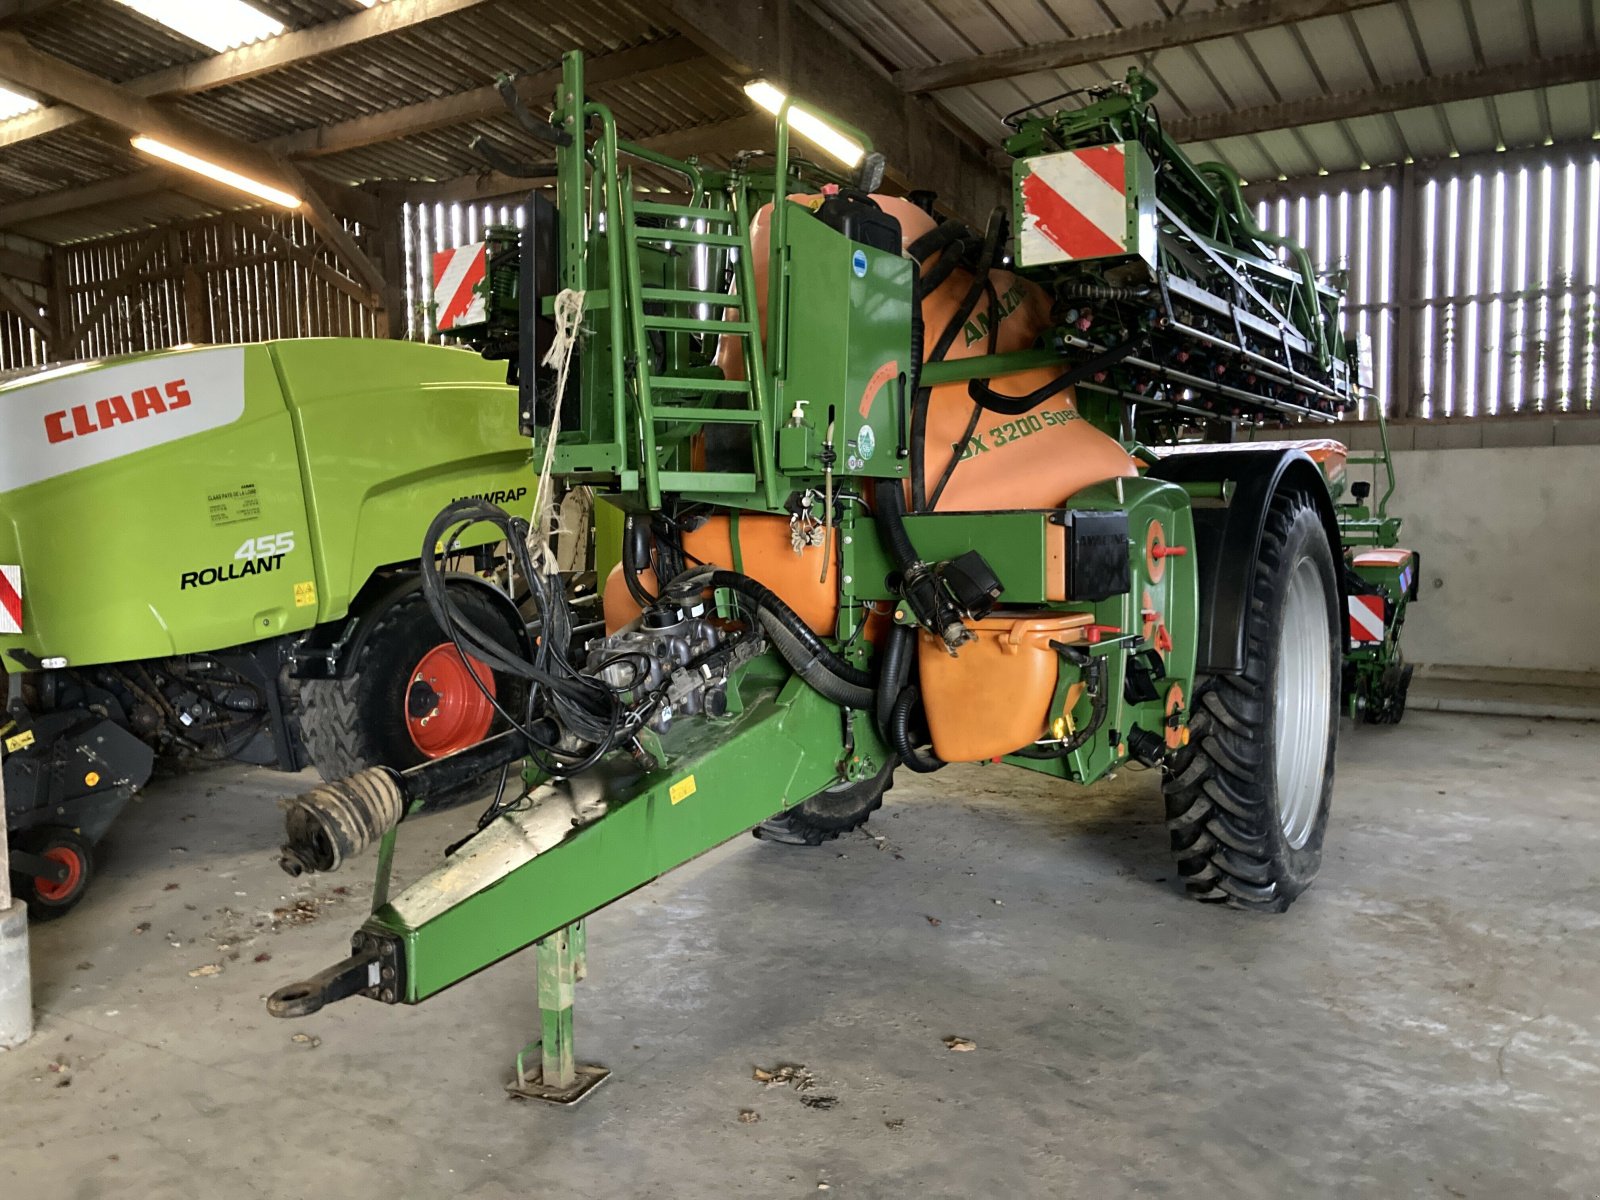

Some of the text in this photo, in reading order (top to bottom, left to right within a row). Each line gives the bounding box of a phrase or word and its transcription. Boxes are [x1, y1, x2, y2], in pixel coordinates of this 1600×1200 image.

[44, 379, 191, 444] CLAAS
[989, 414, 1043, 447] 3200
[234, 531, 295, 561] 455
[180, 553, 285, 590] ROLLANT
